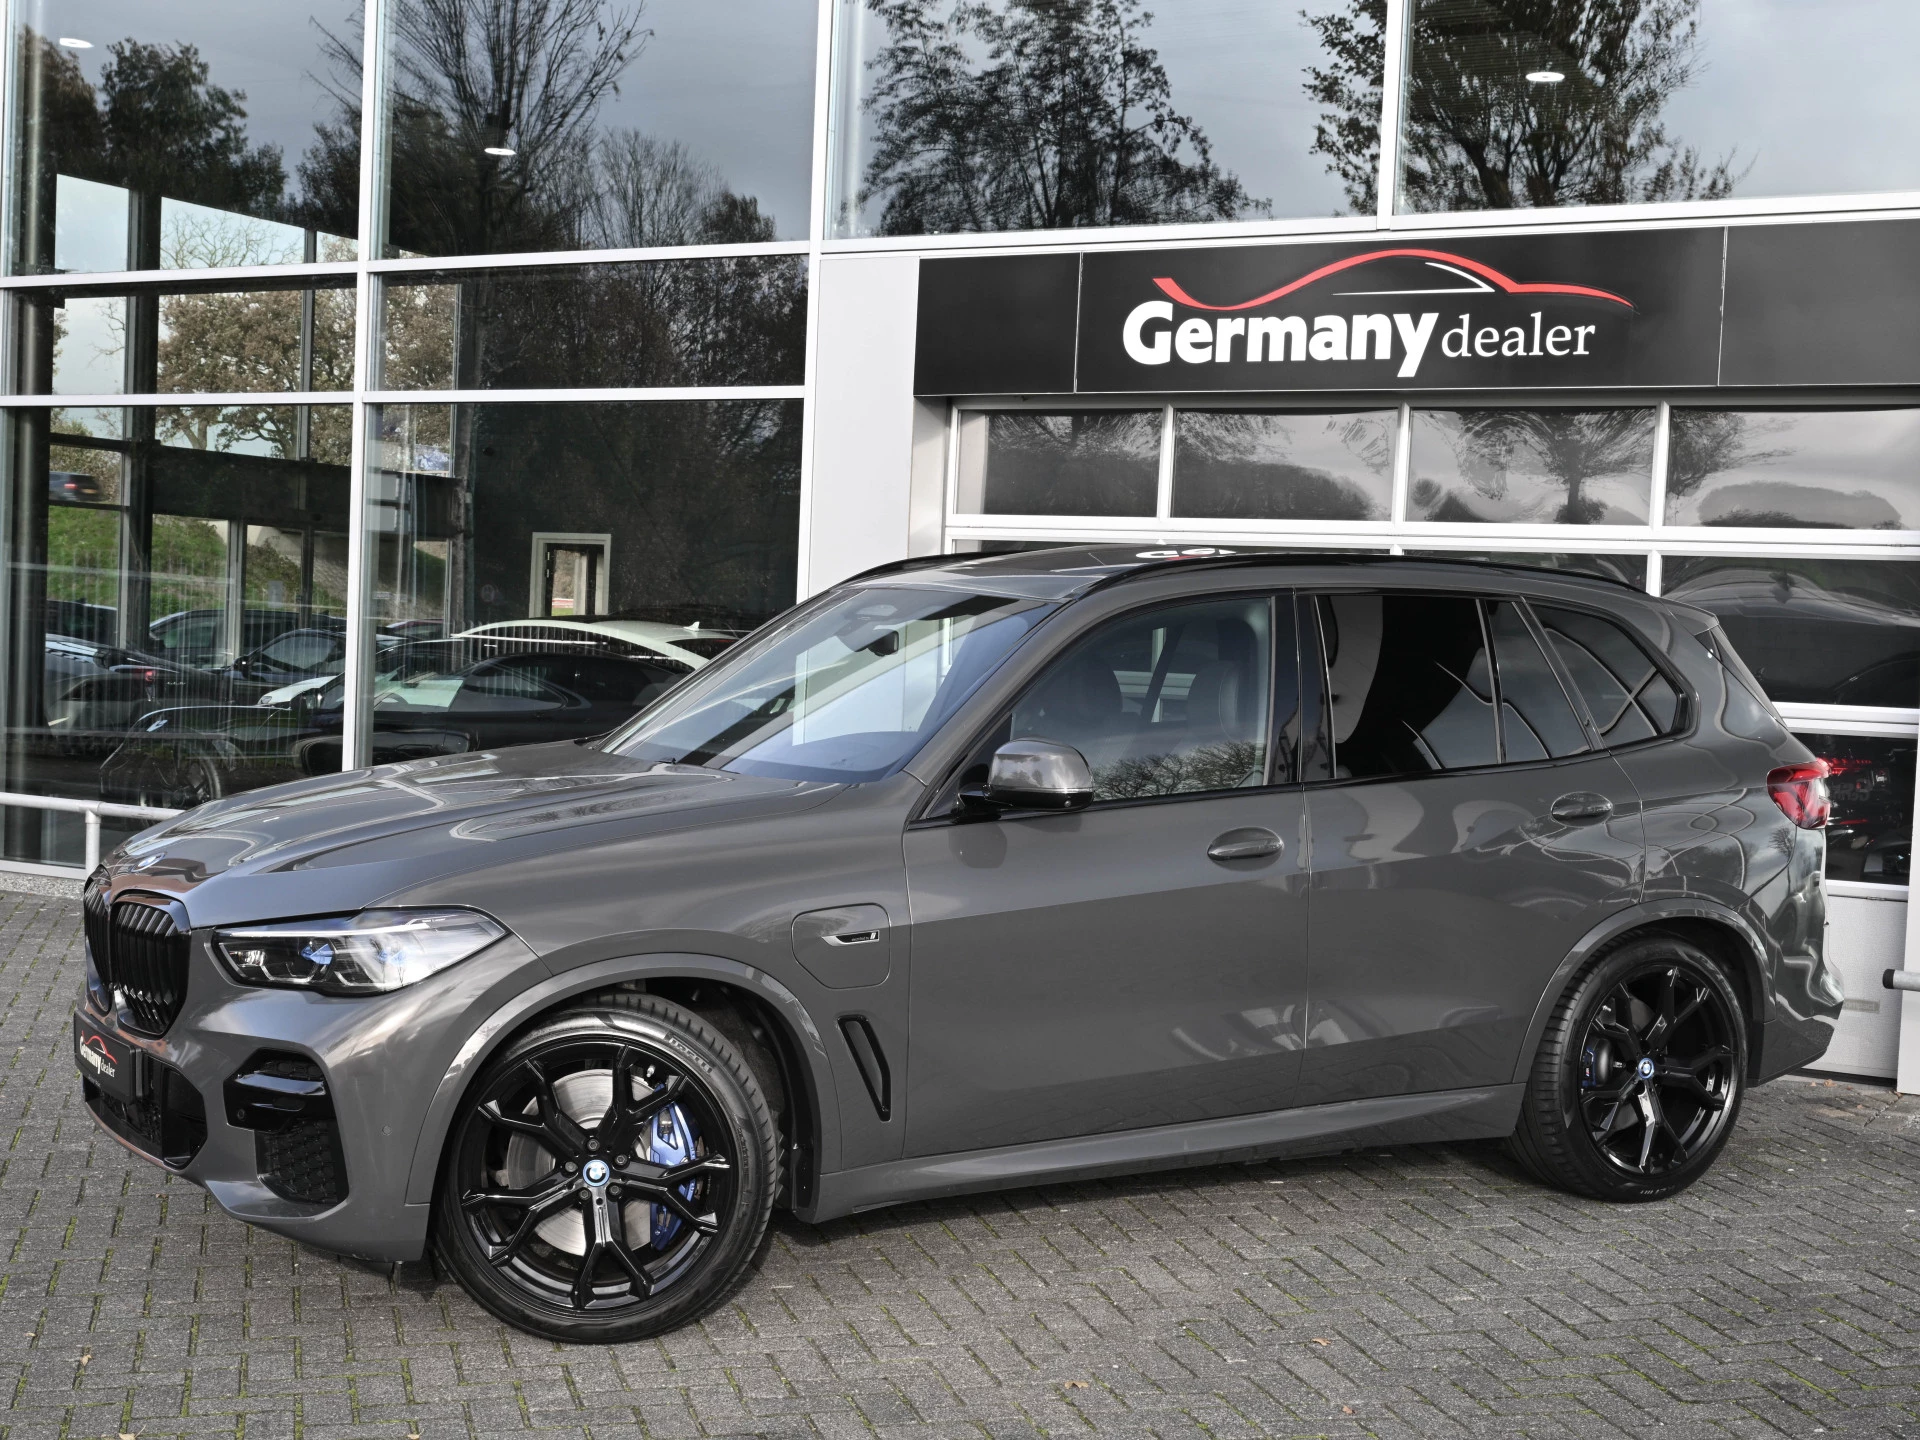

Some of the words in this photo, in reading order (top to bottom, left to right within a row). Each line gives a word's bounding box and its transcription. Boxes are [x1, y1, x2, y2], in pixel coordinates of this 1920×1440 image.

[1123, 300, 1439, 377] Germany
[1441, 311, 1596, 357] dealer
[80, 1036, 101, 1074] Germany
[100, 1059, 115, 1077] dealer
